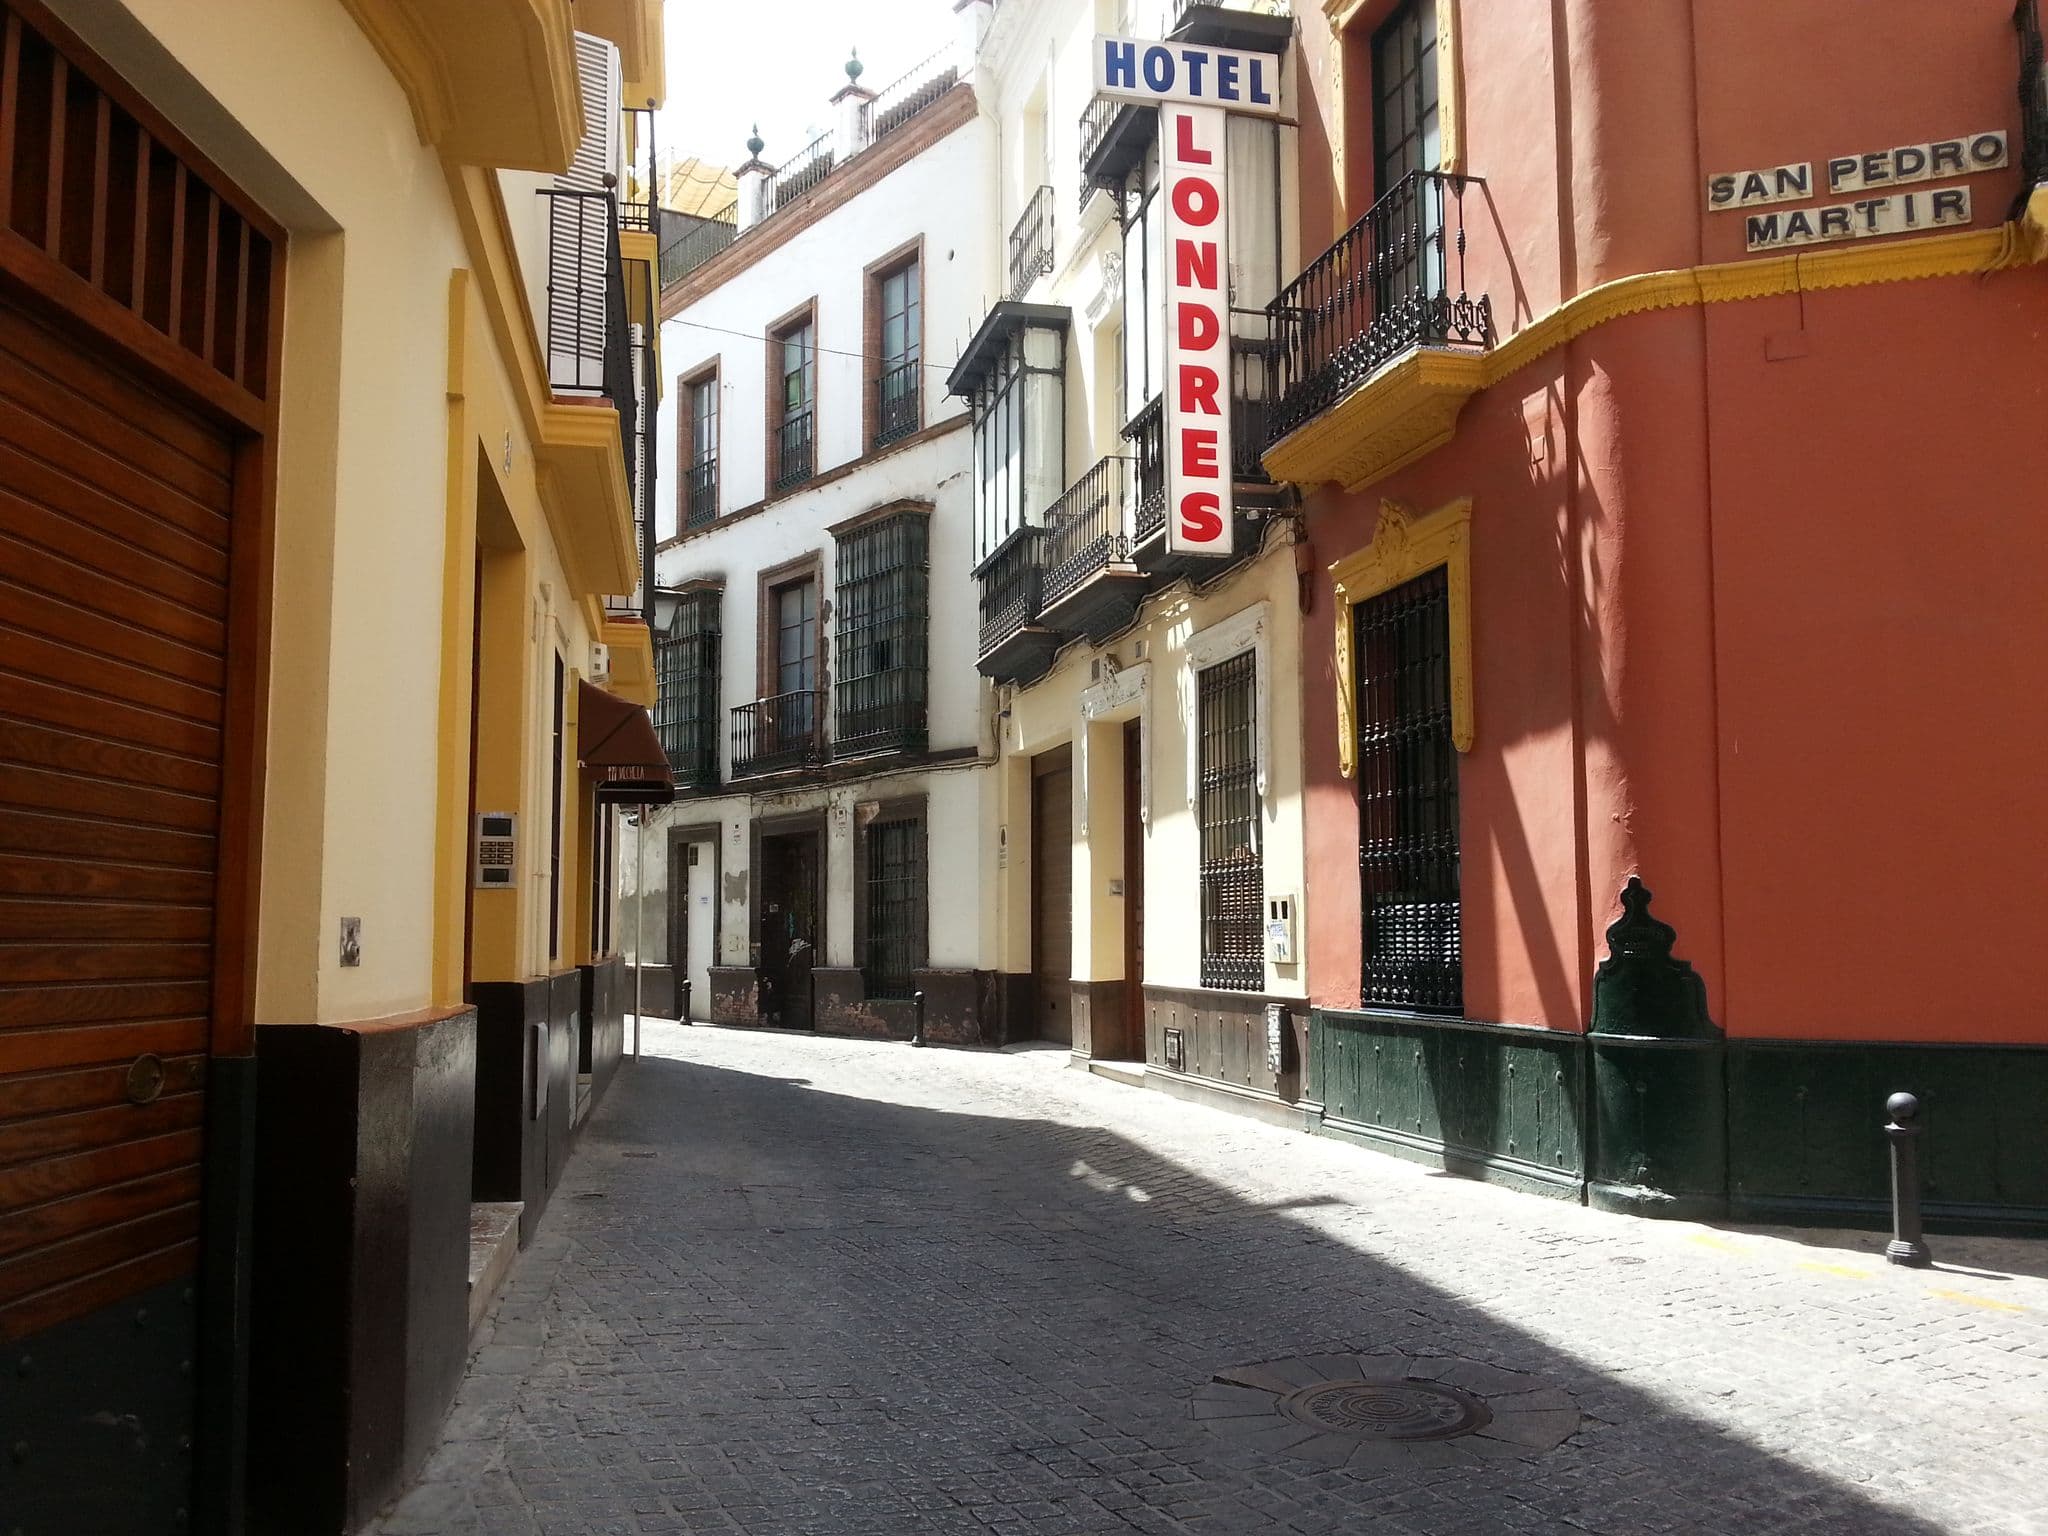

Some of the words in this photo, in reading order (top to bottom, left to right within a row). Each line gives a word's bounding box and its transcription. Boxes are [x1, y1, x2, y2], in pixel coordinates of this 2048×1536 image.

[1105, 40, 1271, 104] HOTEL
[1710, 165, 1808, 204] SAN
[1830, 134, 2003, 189] PEDRO
[1747, 189, 1965, 244] MARTIR
[1171, 115, 1223, 542] LONDRES
